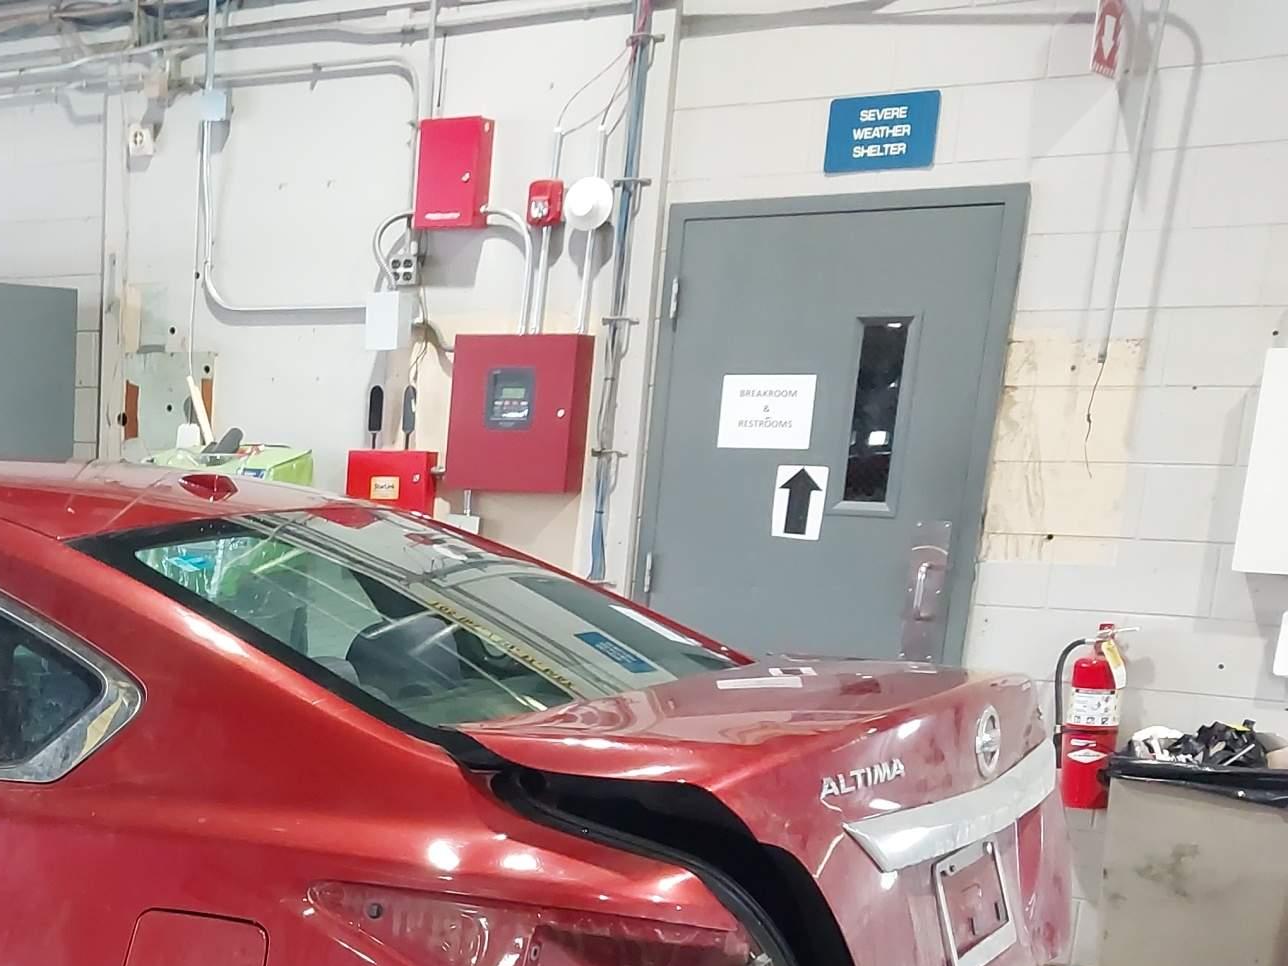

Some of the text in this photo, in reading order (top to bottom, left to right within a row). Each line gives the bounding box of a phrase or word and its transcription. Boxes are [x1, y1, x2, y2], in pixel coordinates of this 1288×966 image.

[859, 106, 909, 122] SEVERE
[852, 124, 911, 141] WEATHER
[852, 142, 907, 158] SHELTER
[739, 389, 798, 398] BREAKROOM
[762, 404, 770, 413] &
[737, 419, 793, 429] RESTROOMS
[821, 758, 905, 799] ALTIMA
